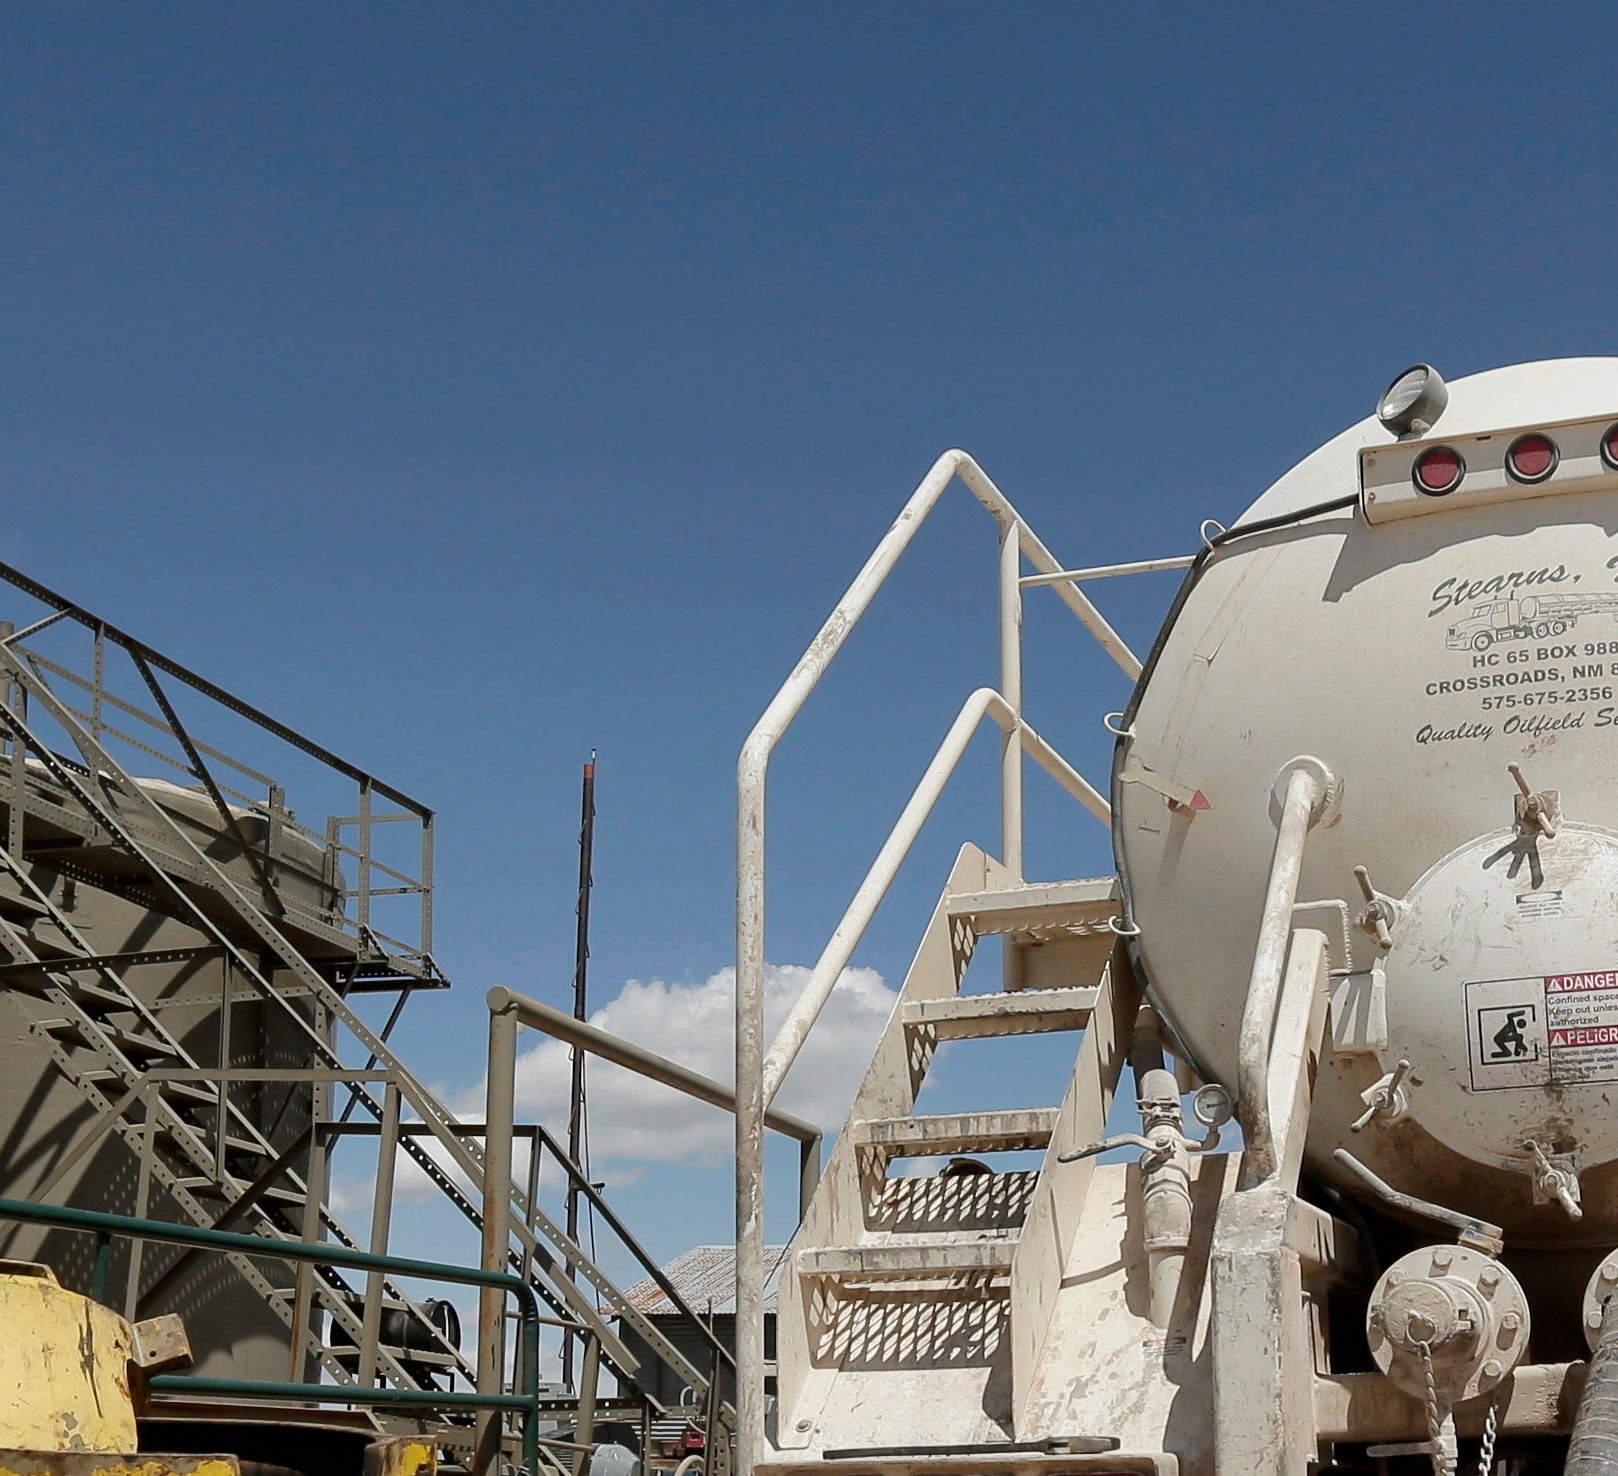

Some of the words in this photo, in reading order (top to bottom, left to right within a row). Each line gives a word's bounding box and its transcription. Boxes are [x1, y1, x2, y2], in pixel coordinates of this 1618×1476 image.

[1472, 653, 1500, 668] HC
[1506, 649, 1530, 664] 65
[1536, 644, 1578, 661] BOX
[1425, 667, 1565, 696] CROSSROADS,
[1572, 664, 1603, 679] NM
[1481, 686, 1613, 710] 575-675-2356
[1415, 720, 1493, 745] Quality
[1503, 711, 1586, 738] Oilfield
[1548, 994, 1590, 1005] Confined
[1548, 1006, 1573, 1016] Keep
[1575, 1006, 1590, 1014] out
[1550, 1016, 1599, 1026] authorized
